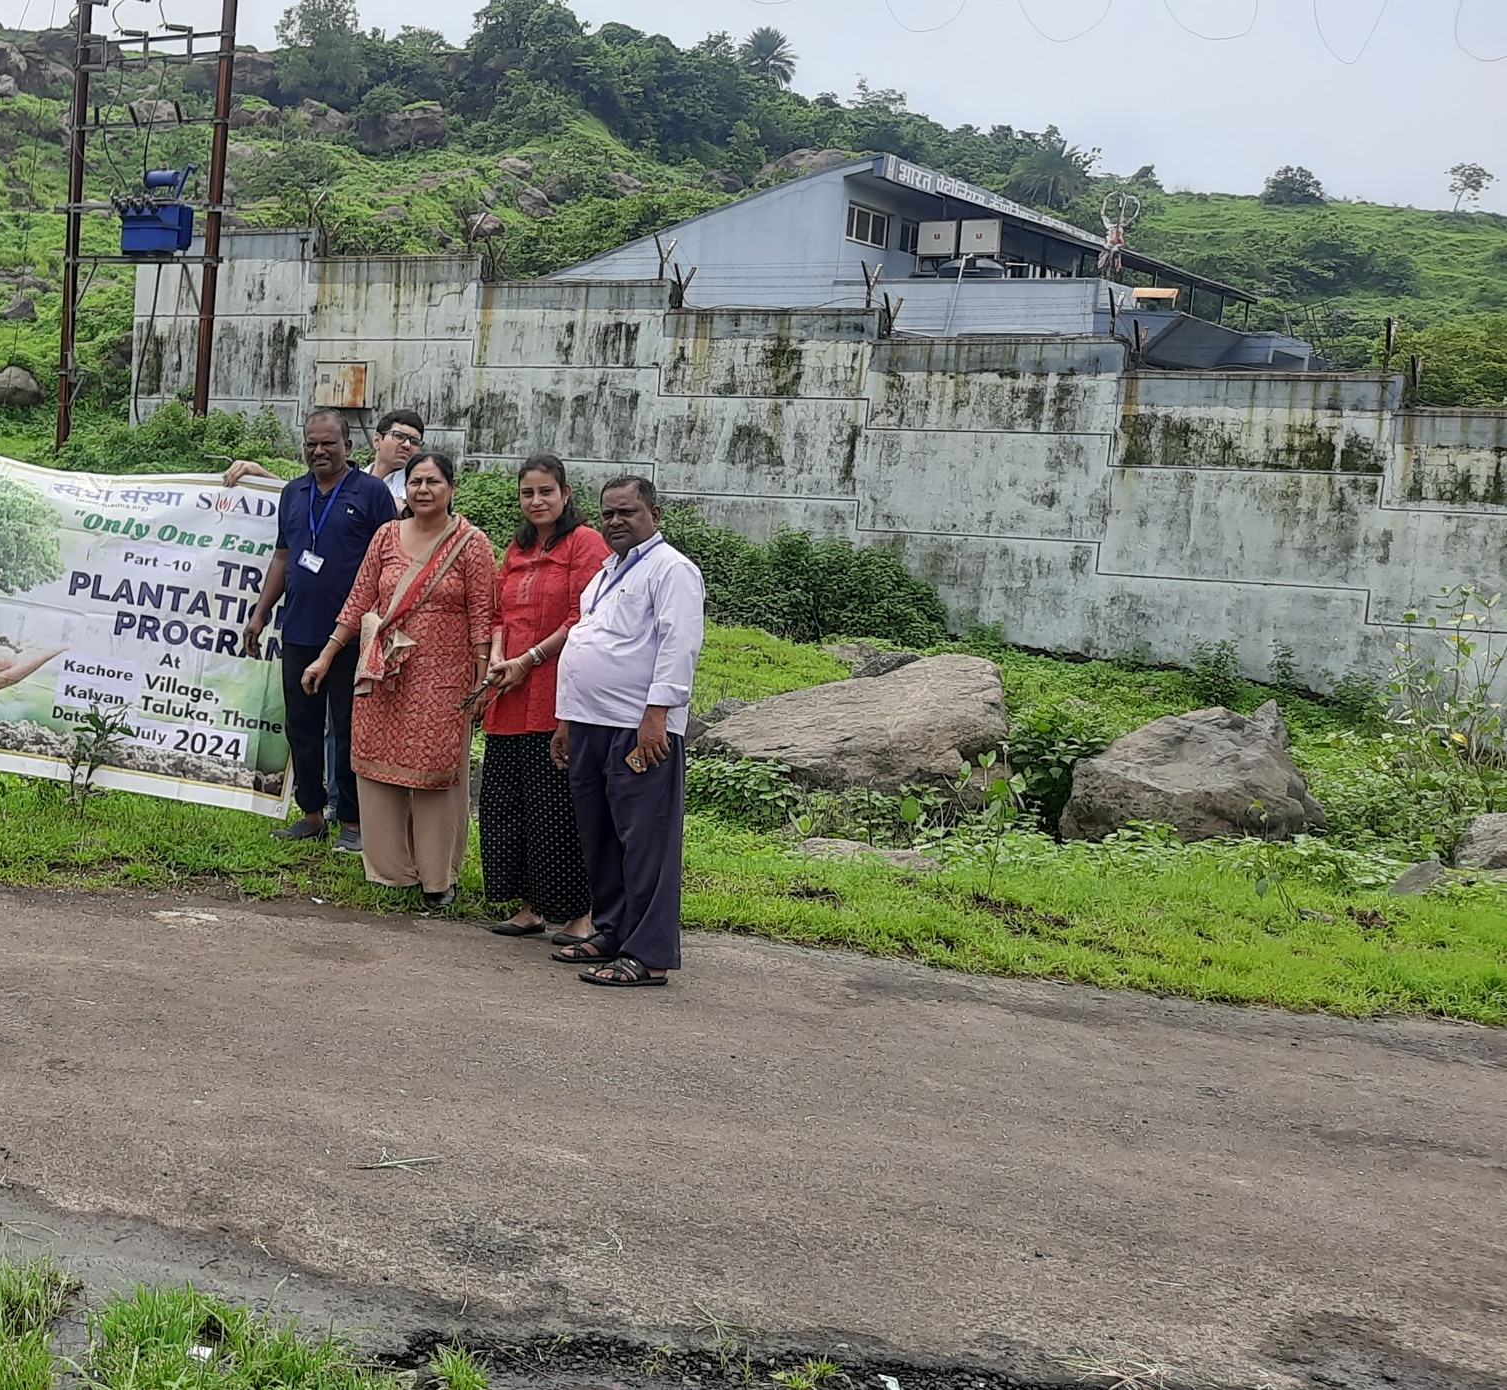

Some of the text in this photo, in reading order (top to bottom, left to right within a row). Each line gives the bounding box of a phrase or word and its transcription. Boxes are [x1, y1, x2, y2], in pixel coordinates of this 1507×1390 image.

[120, 486, 184, 507] संस्था
[195, 492, 276, 519] SUAD
[157, 525, 213, 548] One
[220, 533, 274, 557] Ear
[123, 551, 159, 567] Part
[217, 560, 262, 594] TR
[158, 653, 181, 669] At
[63, 659, 220, 705] Kachore Village,
[64, 684, 283, 734] Kalyan Taluka, Thane
[173, 729, 241, 761] 2024
